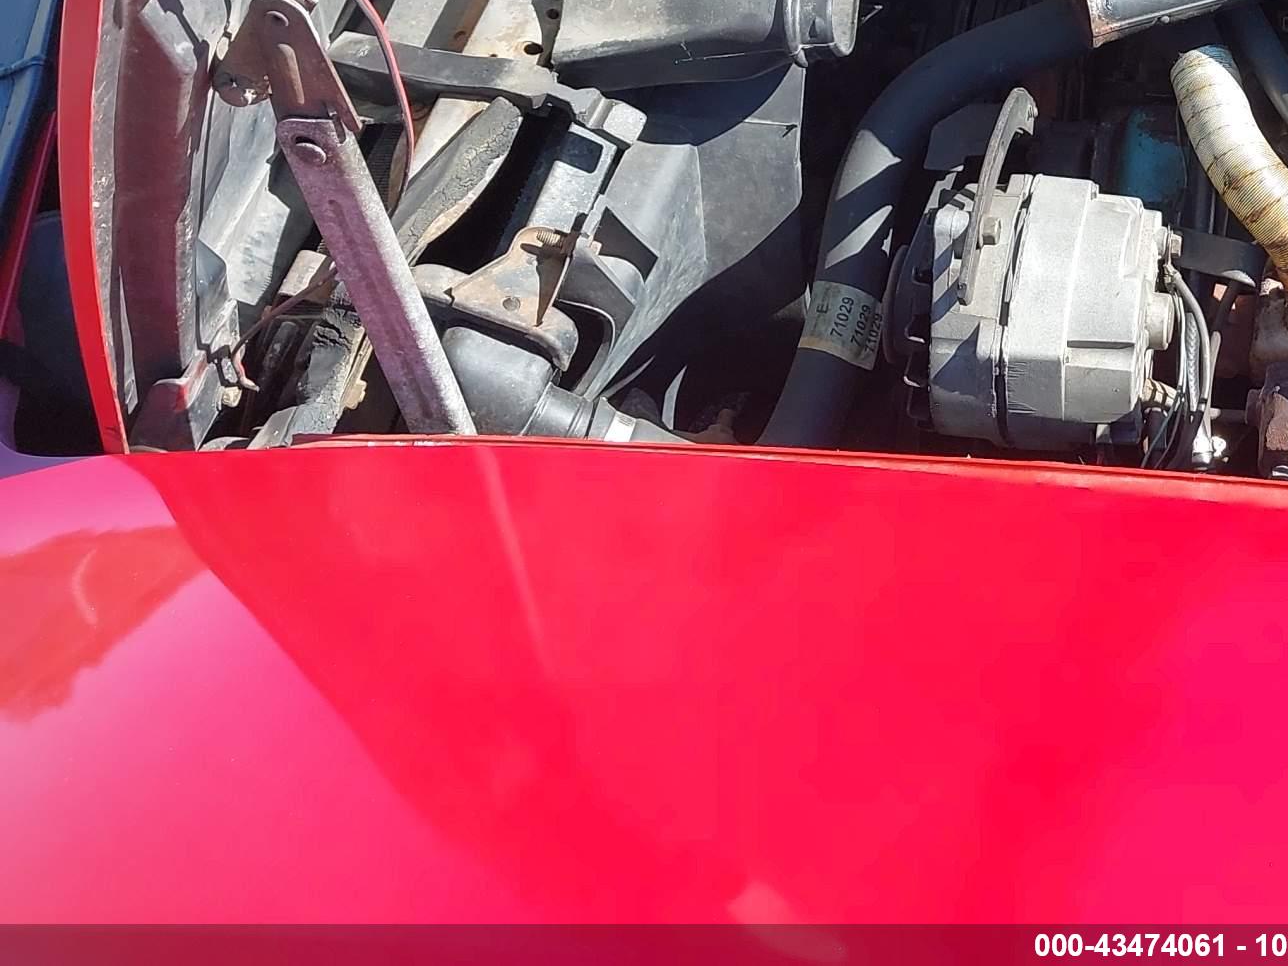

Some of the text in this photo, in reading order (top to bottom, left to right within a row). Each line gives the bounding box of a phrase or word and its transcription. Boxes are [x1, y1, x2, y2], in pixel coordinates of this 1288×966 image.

[830, 296, 854, 338] 71029
[850, 304, 871, 347] 71029
[864, 313, 883, 353] 71029
